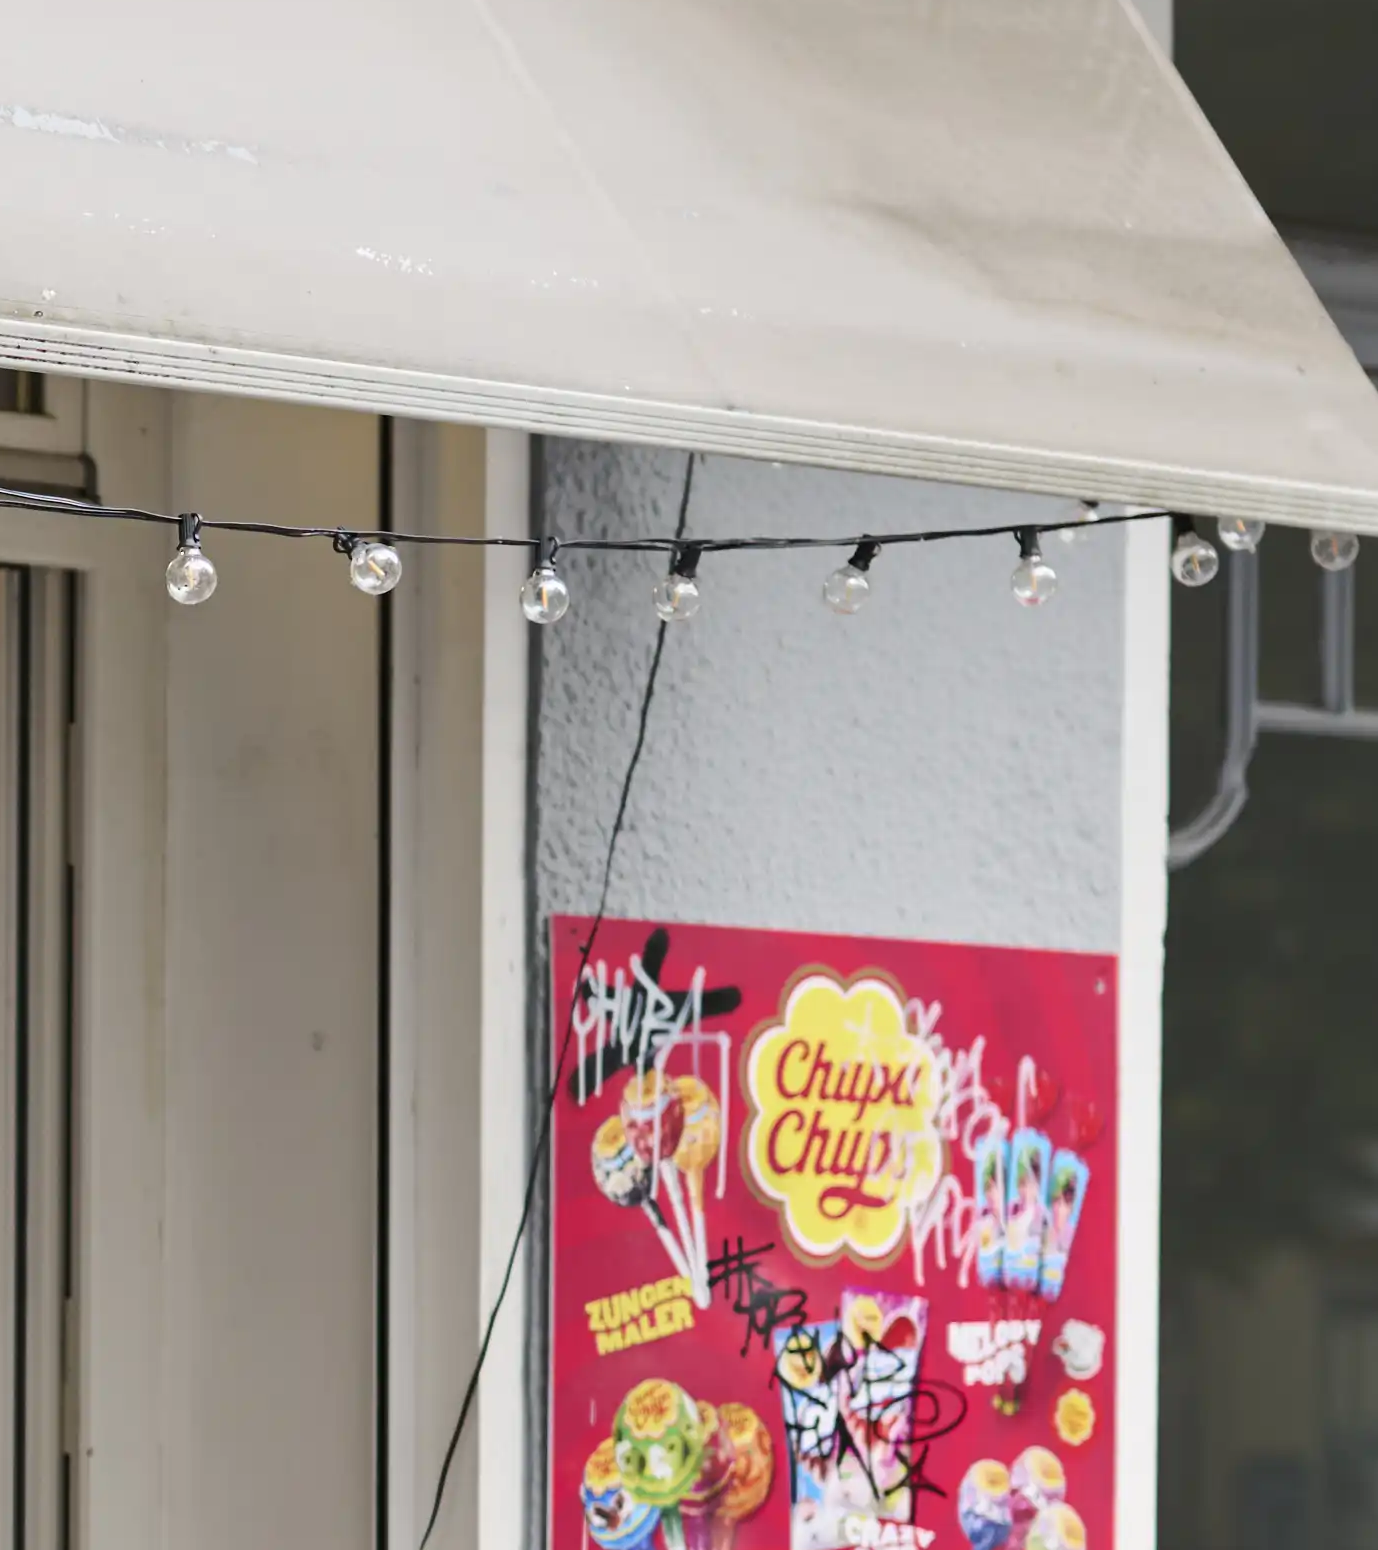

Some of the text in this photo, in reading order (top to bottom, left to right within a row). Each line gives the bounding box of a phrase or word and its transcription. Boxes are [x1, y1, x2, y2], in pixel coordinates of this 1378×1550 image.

[774, 1037, 923, 1122] Chupa
[585, 1275, 693, 1332] ZUNGEN
[595, 1298, 696, 1357] MALER
